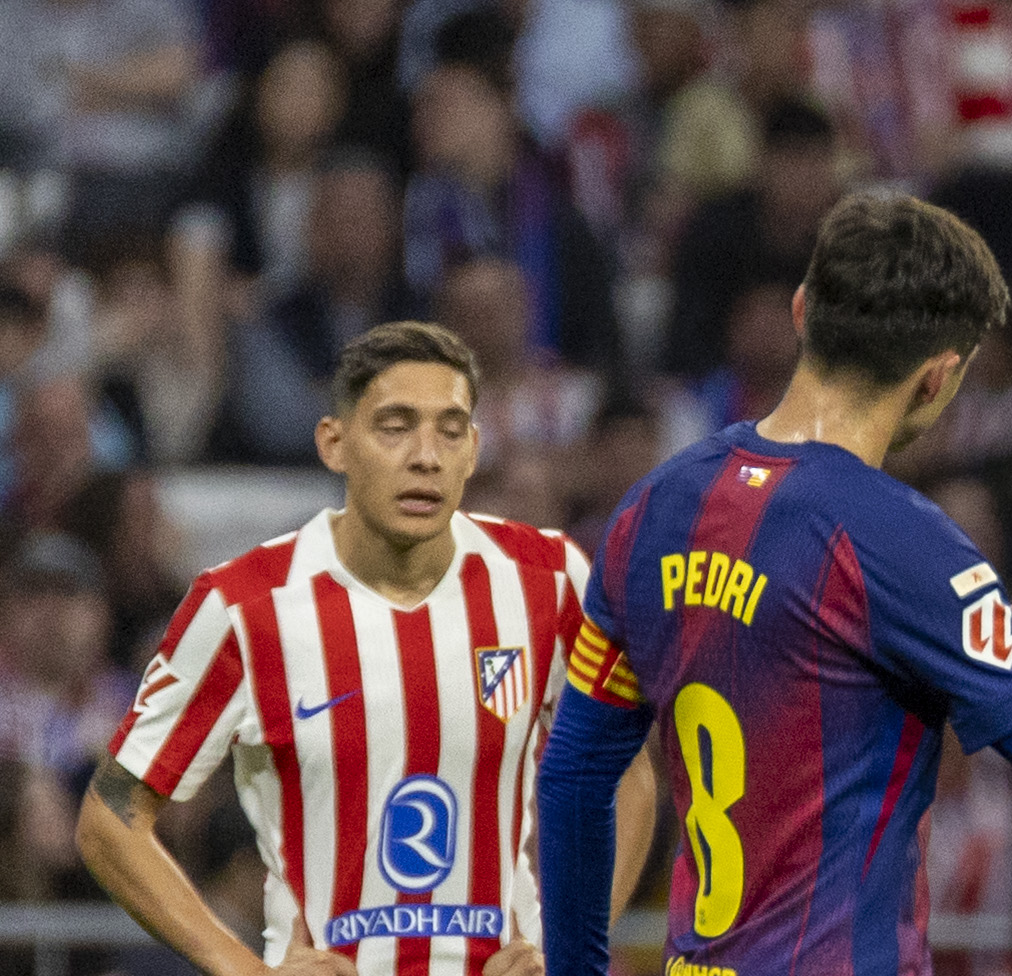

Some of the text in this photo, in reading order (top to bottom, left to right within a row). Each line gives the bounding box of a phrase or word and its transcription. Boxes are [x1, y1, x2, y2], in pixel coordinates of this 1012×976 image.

[660, 550, 768, 627] PEDRI
[674, 682, 746, 938] 8
[330, 906, 498, 944] RIYADH AIR
